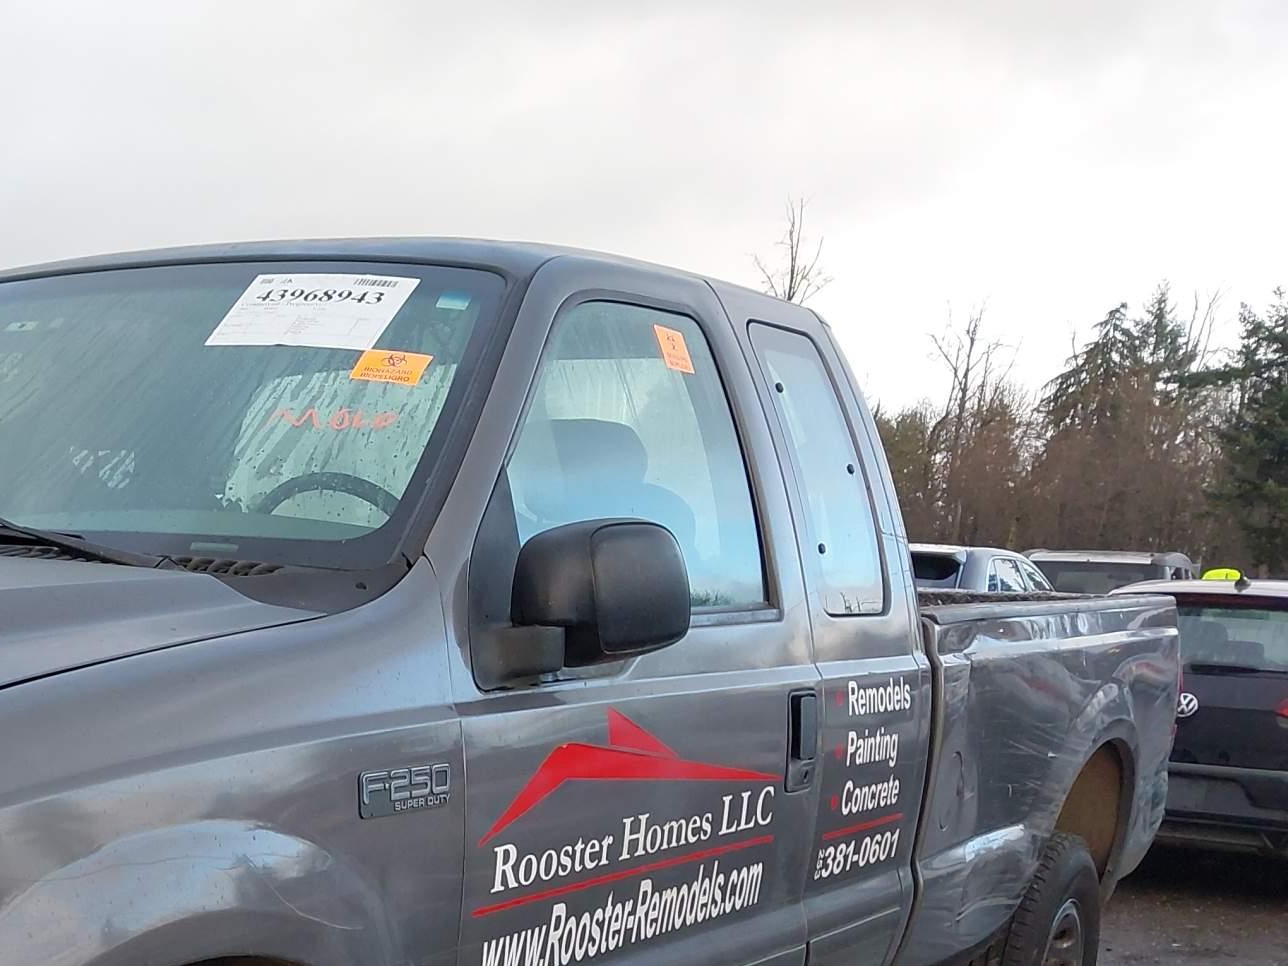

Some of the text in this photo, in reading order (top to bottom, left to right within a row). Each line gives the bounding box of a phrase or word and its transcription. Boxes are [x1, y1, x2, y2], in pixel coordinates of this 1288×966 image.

[255, 288, 386, 305] 43968943
[847, 676, 912, 716] Remodels
[846, 727, 899, 768] Painting
[395, 793, 451, 811] SUPER DUTY
[841, 774, 900, 816] Concrete
[490, 786, 775, 894] Rooster Homes LLC
[821, 828, 901, 878] 381-0601
